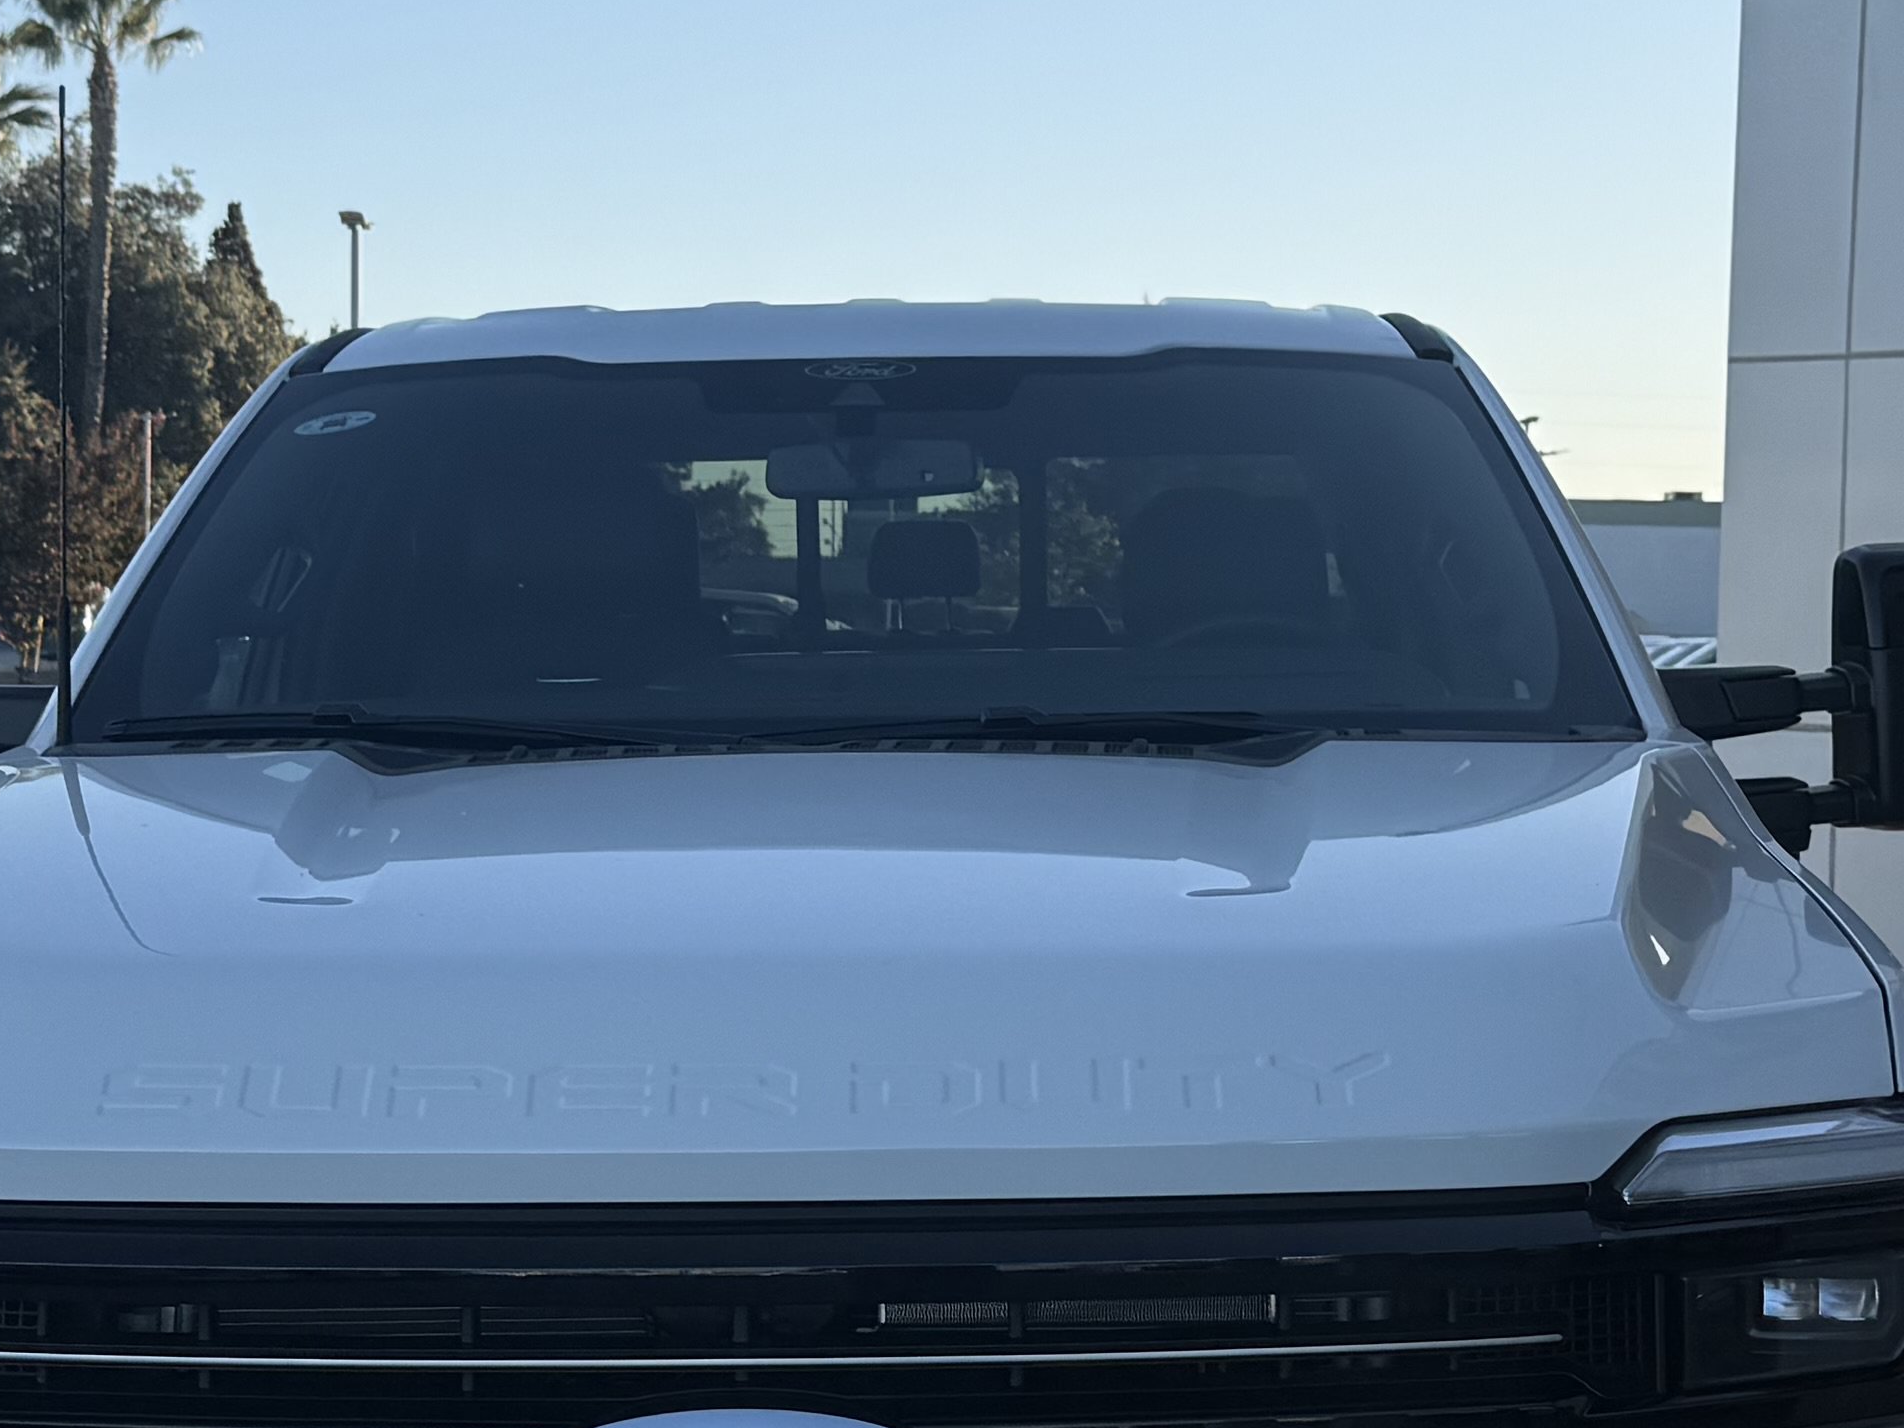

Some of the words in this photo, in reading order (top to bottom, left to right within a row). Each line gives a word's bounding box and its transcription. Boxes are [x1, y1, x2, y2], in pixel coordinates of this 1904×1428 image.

[825, 363, 897, 376] Ford
[95, 1063, 798, 1119] SUPER
[847, 1050, 1392, 1115] DUTY
